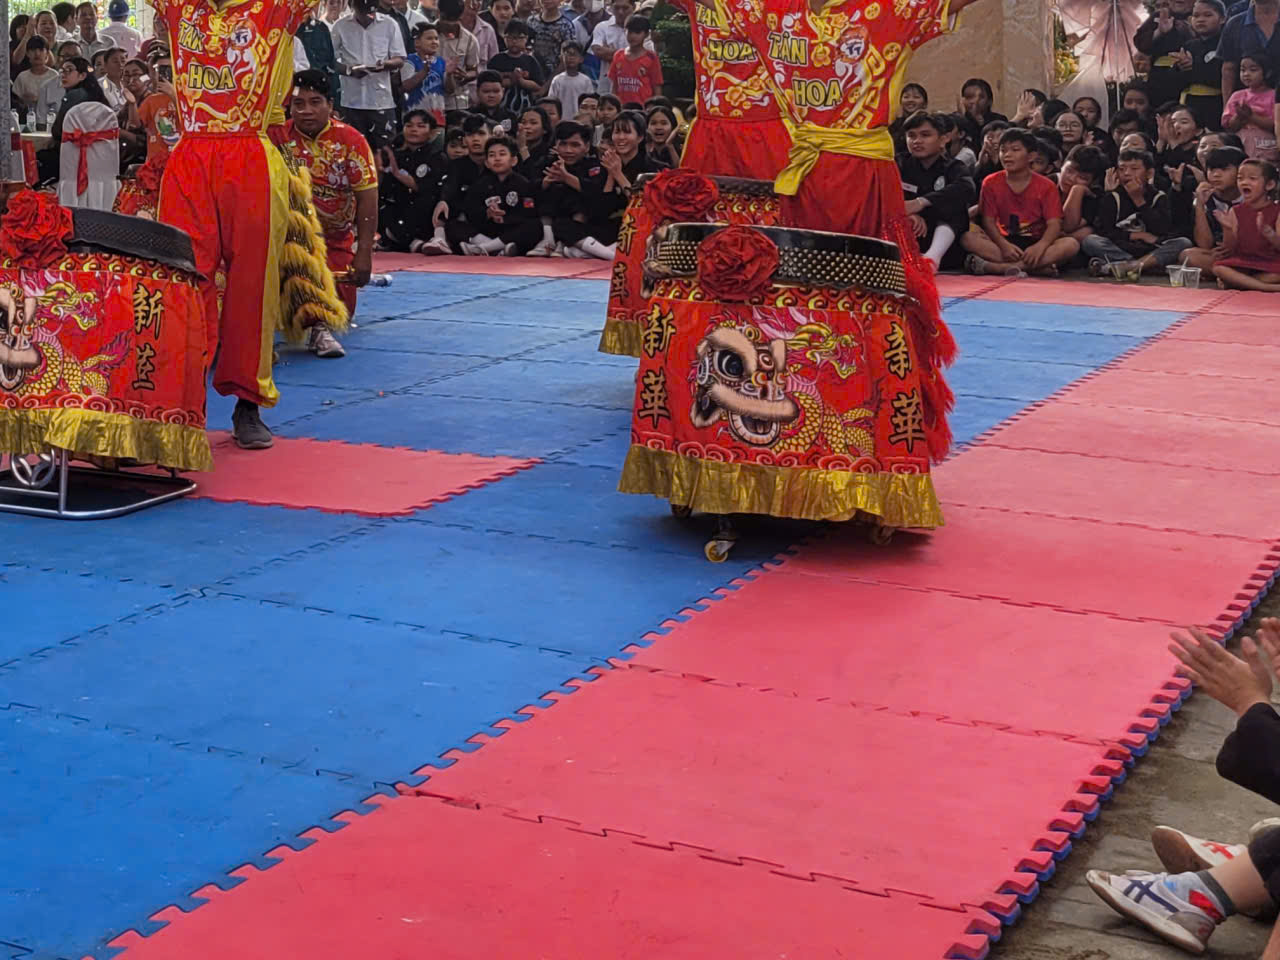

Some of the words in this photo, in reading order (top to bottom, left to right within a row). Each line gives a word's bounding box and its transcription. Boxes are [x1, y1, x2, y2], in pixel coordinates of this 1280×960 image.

[707, 38, 755, 62] HOA
[768, 30, 809, 66] TÂN
[188, 62, 237, 91] HOA
[792, 78, 844, 108] HOA
